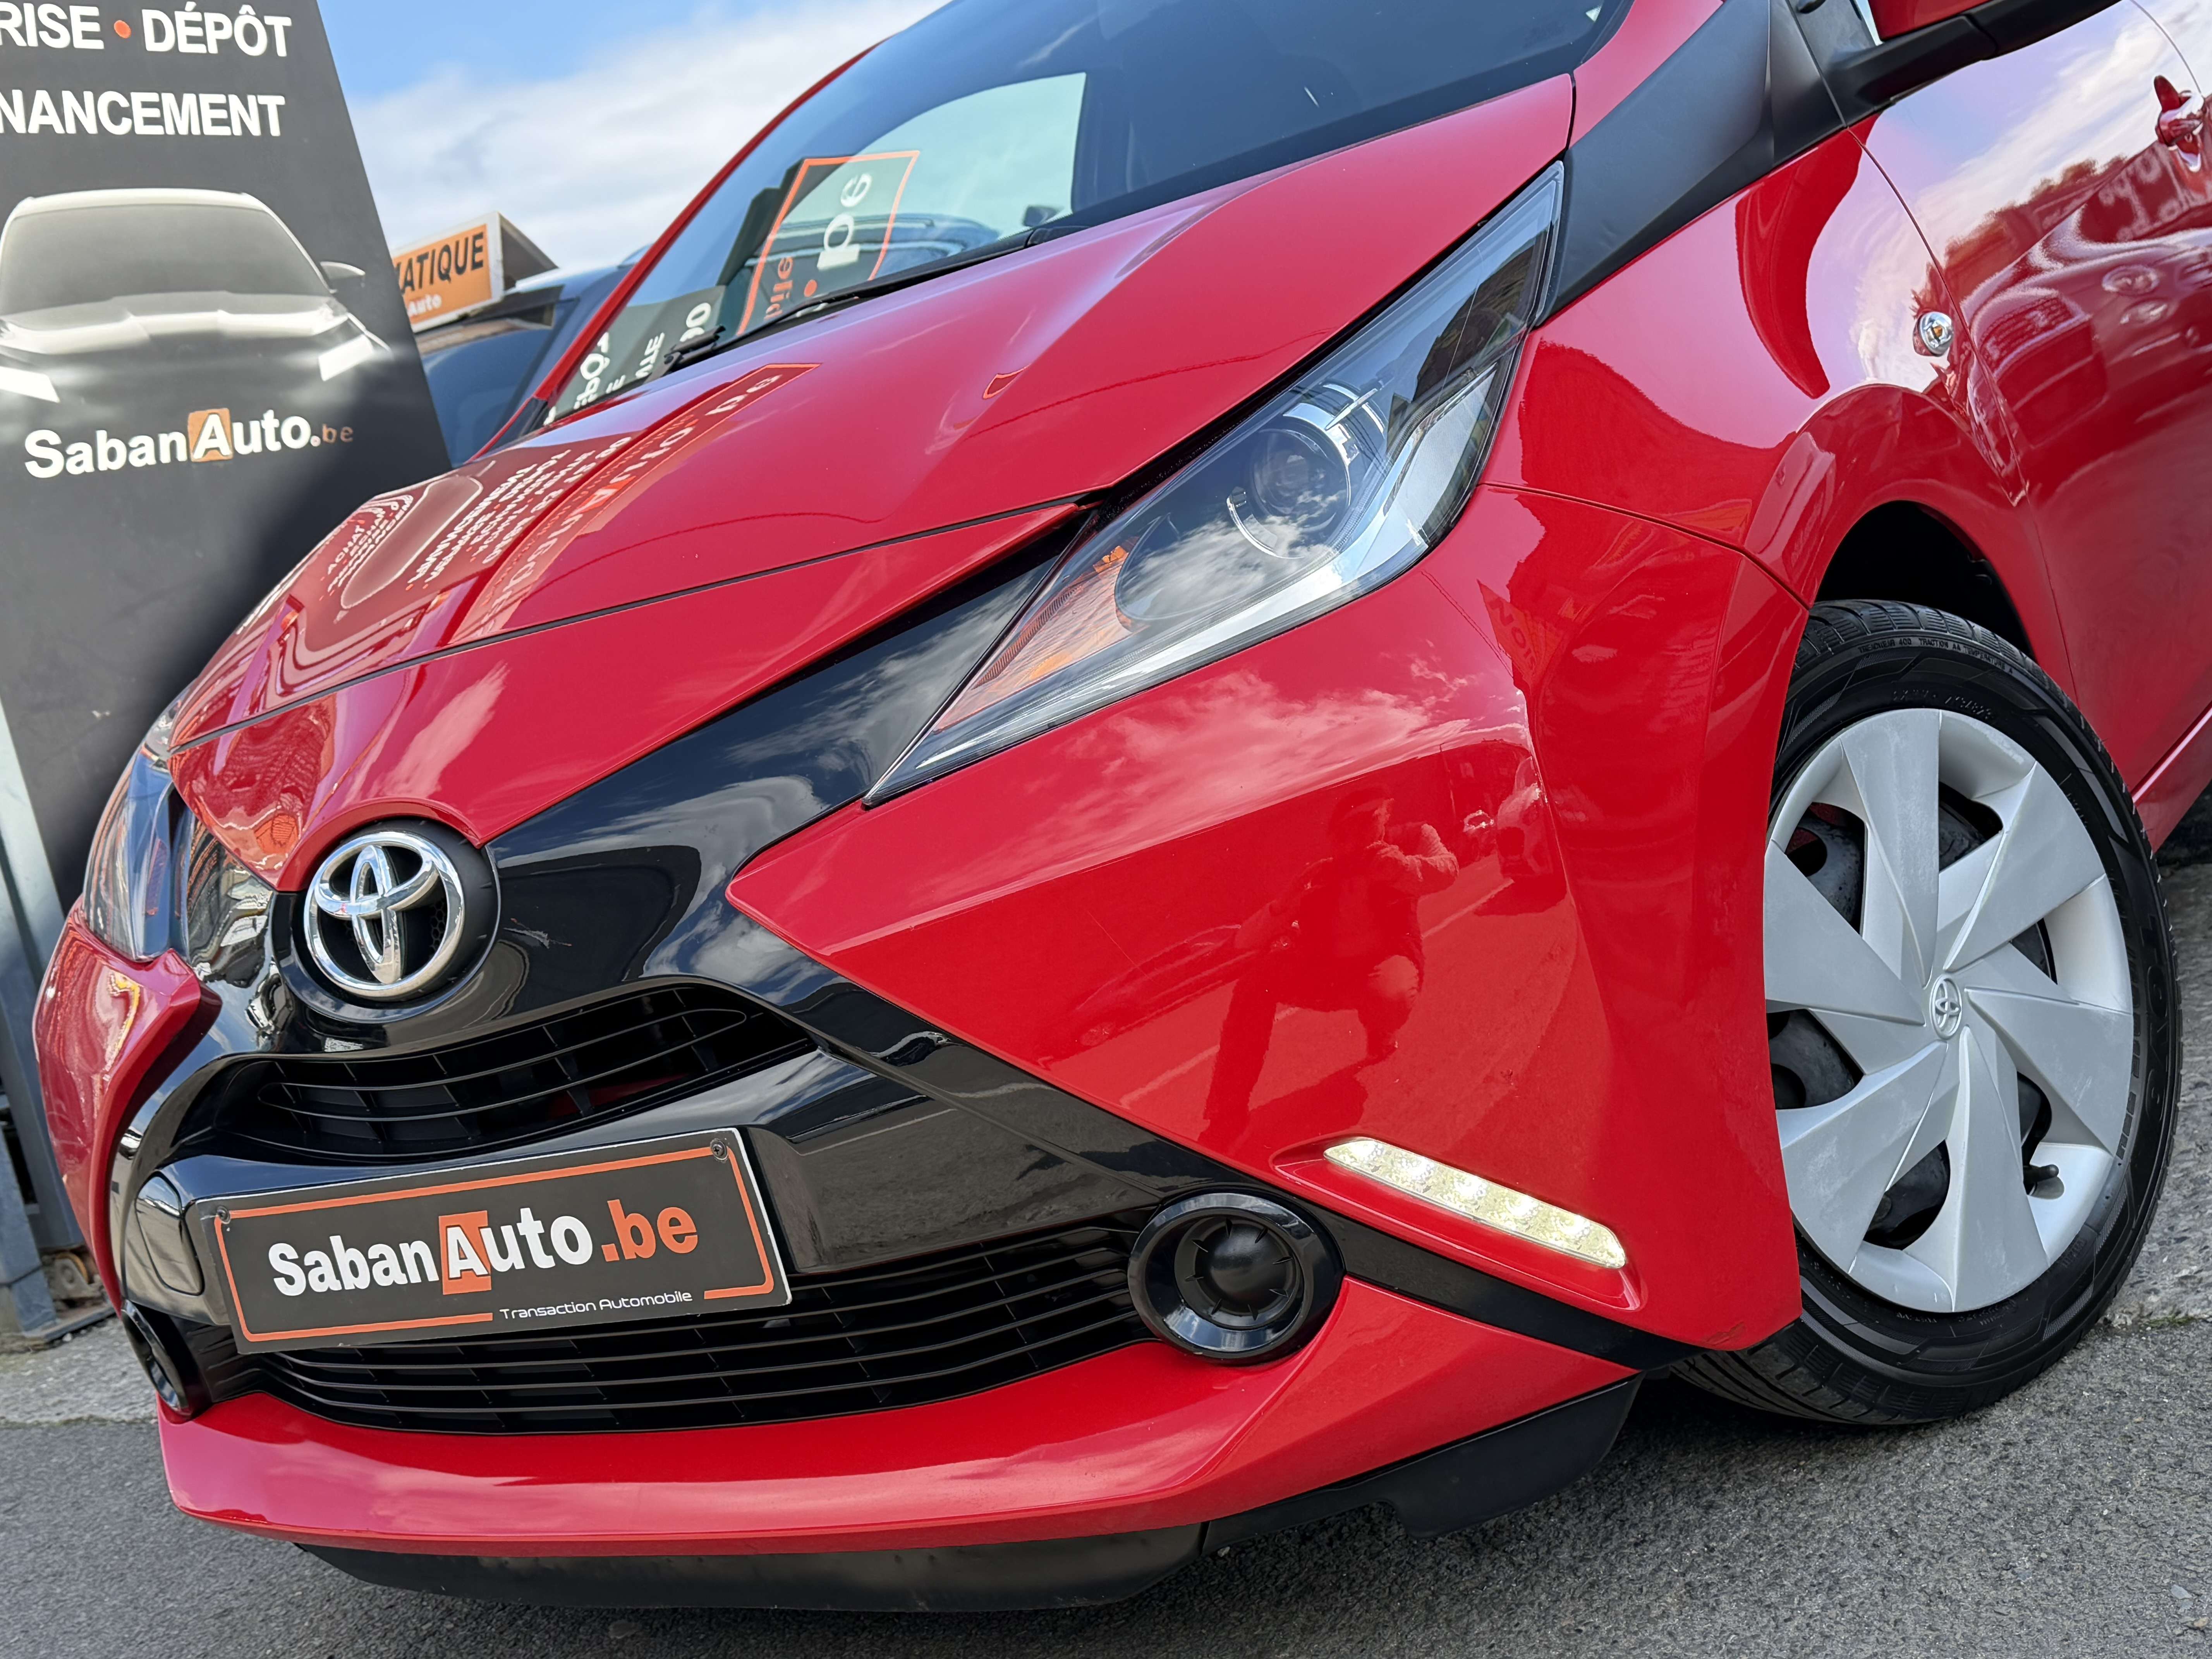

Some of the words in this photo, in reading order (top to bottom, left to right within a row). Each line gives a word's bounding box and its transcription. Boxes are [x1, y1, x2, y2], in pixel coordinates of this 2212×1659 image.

[141, 1, 292, 57] DÉPÔT
[0, 89, 285, 137] NANCEMENT
[24, 409, 354, 478] SabanAuto.be
[268, 1199, 699, 1296] SabanAuto.be
[499, 1302, 597, 1319] Transaction
[599, 1291, 693, 1310] Automobile
